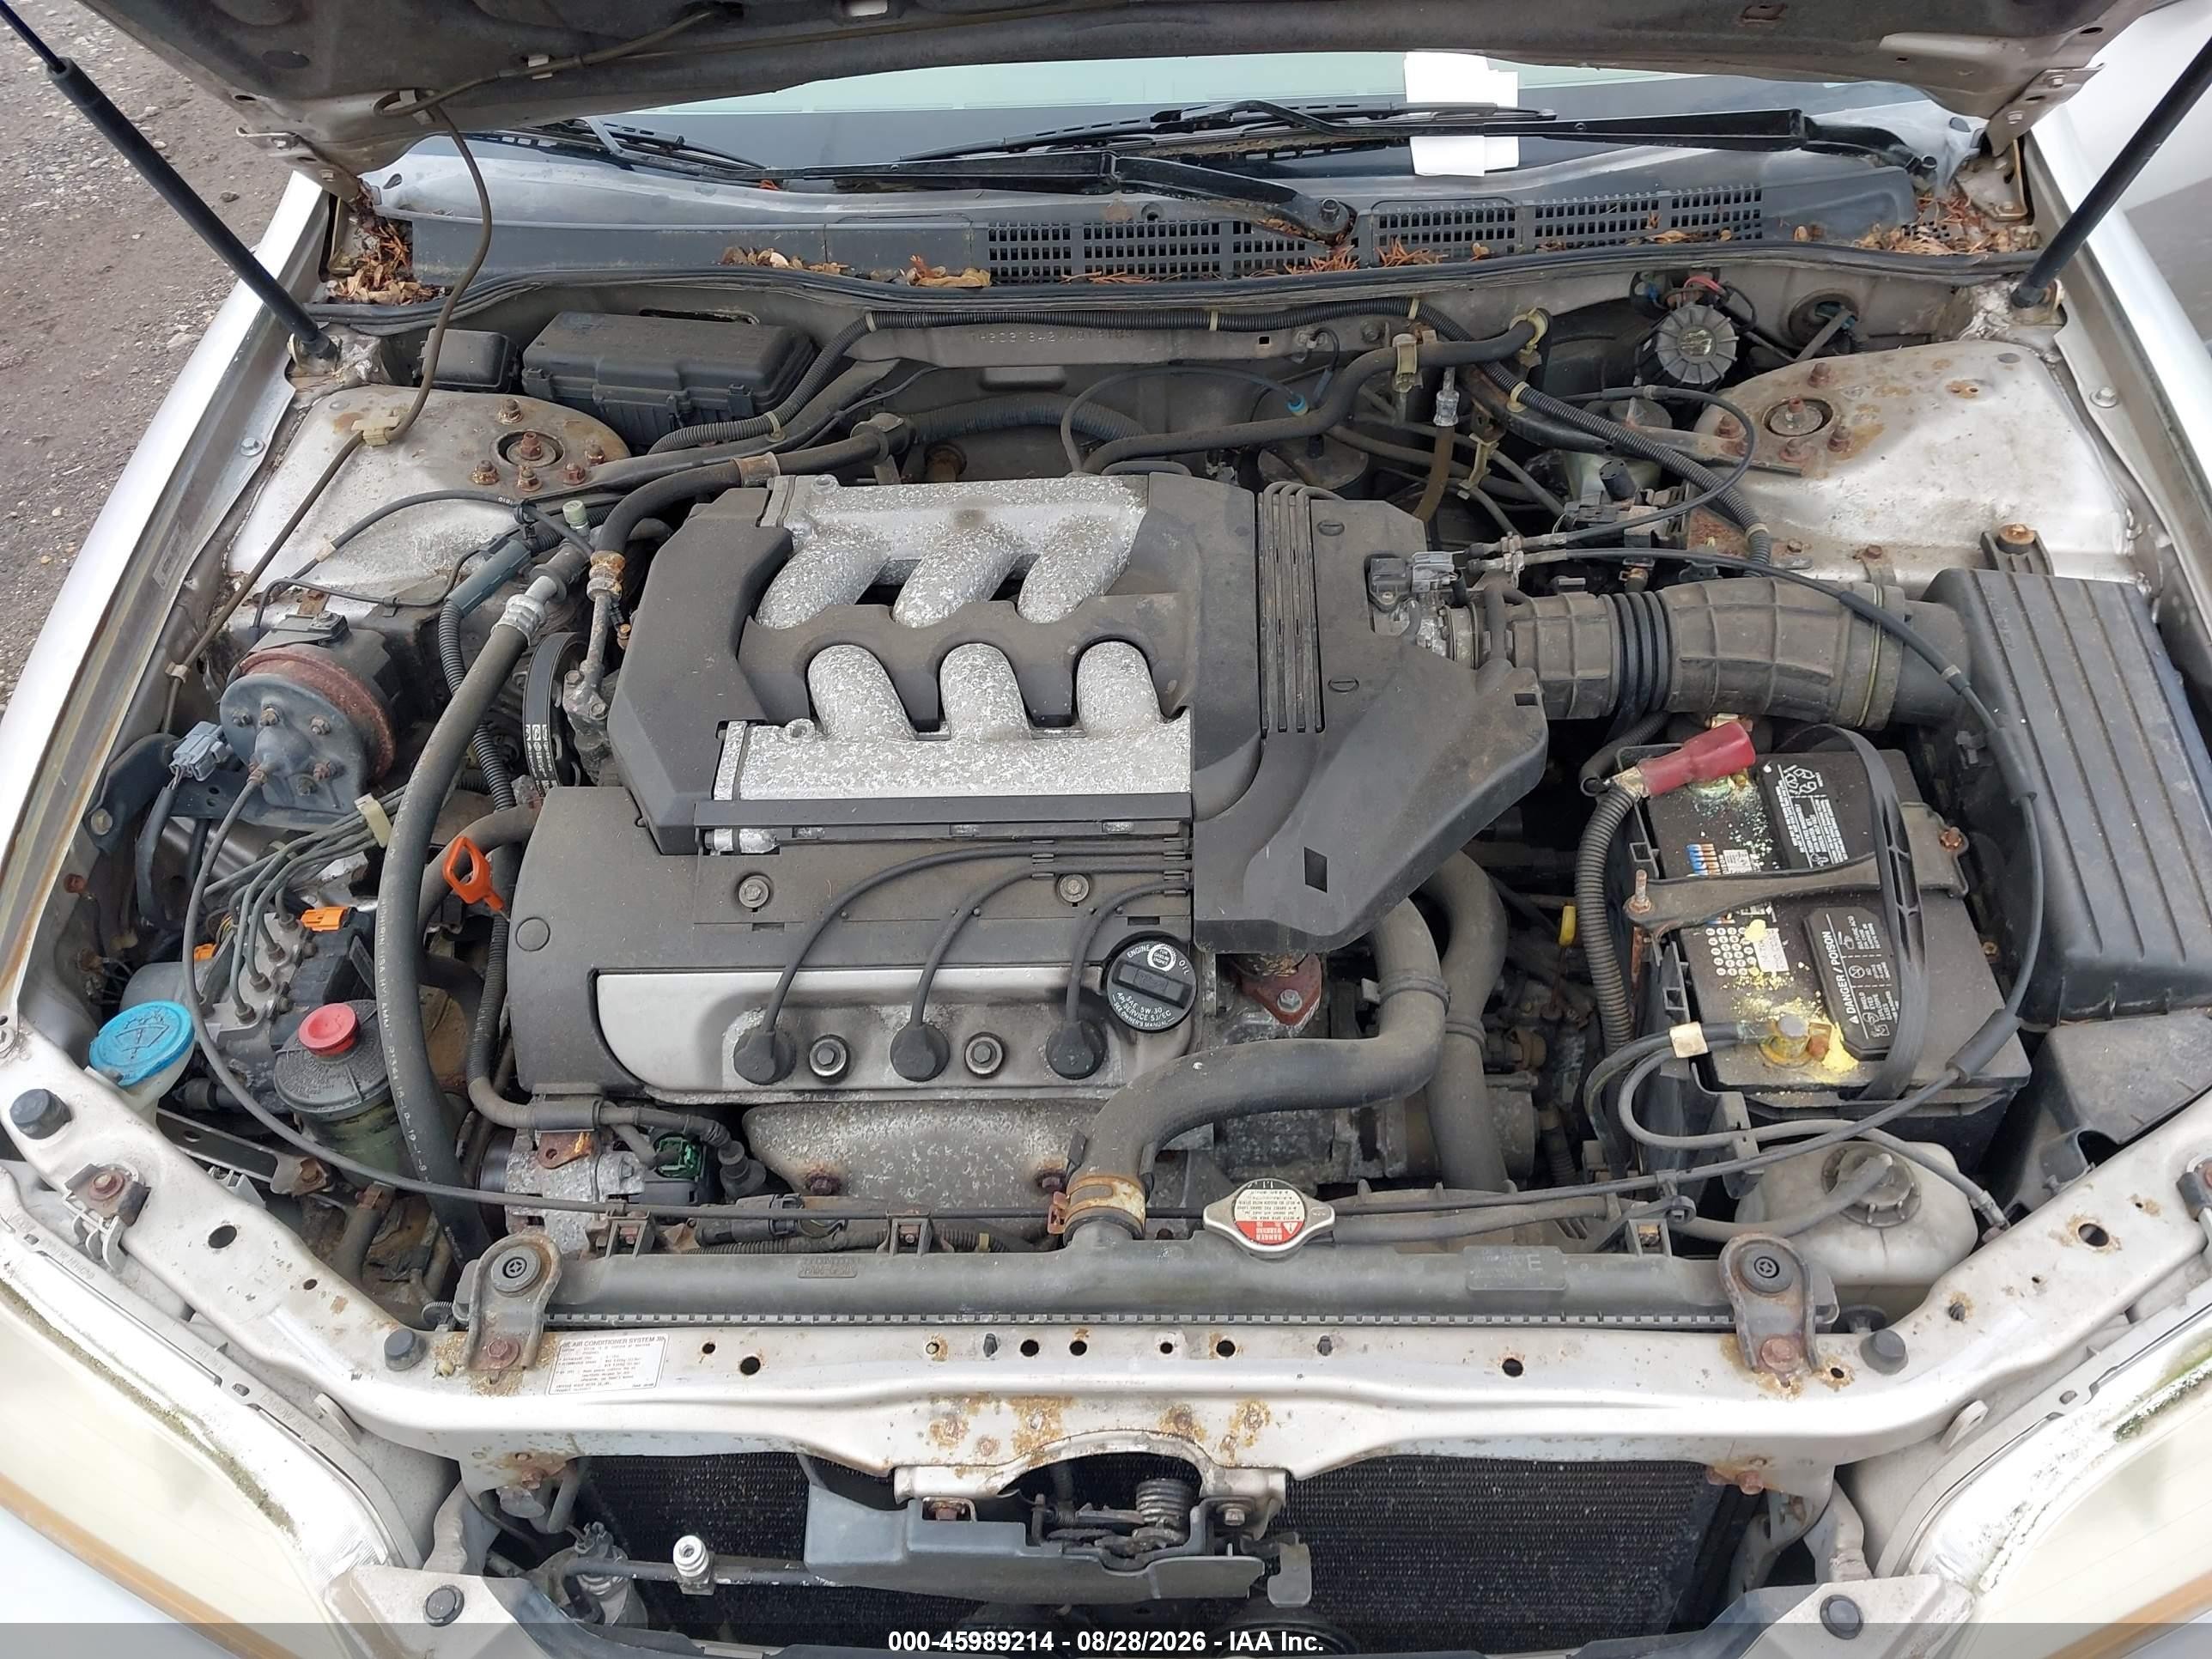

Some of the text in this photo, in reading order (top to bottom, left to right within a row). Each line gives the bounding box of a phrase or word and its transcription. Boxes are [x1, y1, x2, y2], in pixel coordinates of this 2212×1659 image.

[1127, 945, 1189, 975] ENGINE OIL
[1821, 930, 1841, 964] POISON
[1117, 993, 1126, 1004] API
[1123, 1004, 1148, 1021] SERVICE
[1127, 996, 1139, 1009] SAE
[1835, 974, 1856, 1013] DANGER
[1114, 1002, 1122, 1012] SEE
[1121, 1012, 1144, 1026] OWNER'S
